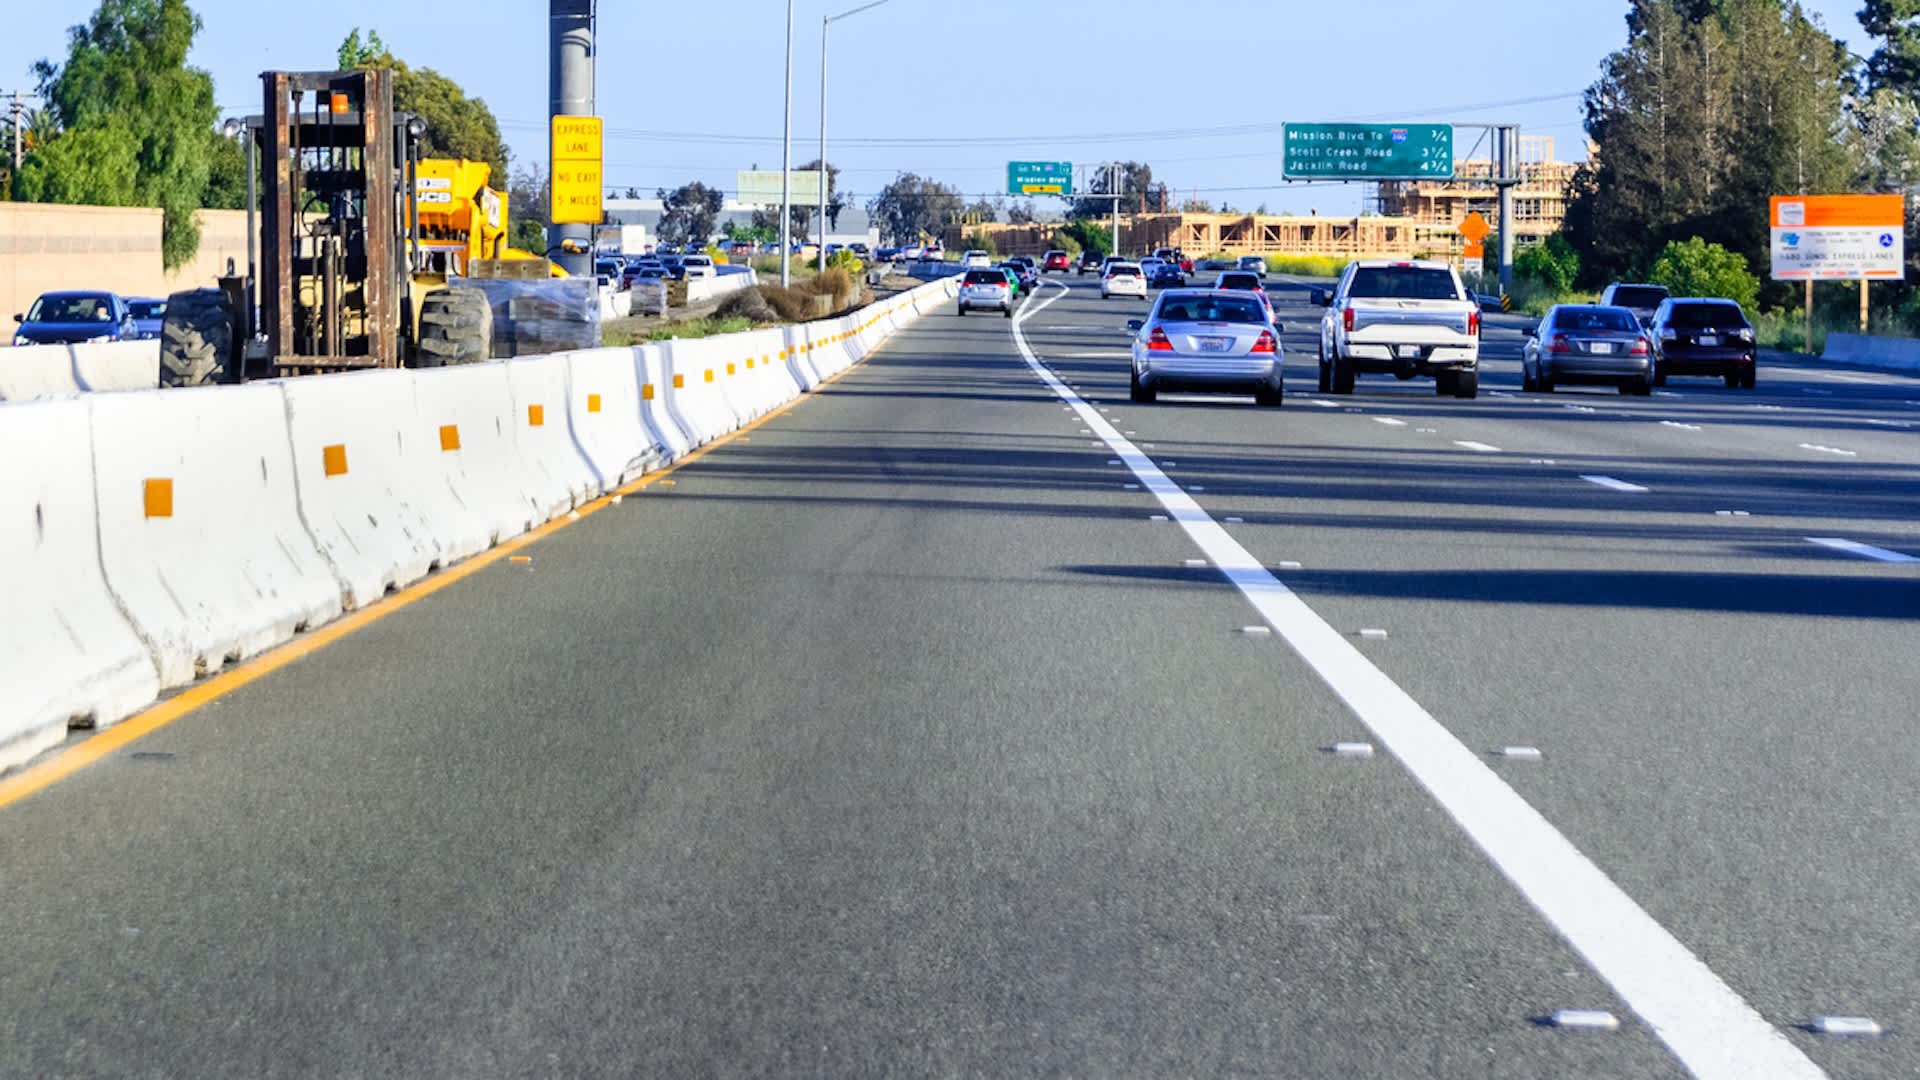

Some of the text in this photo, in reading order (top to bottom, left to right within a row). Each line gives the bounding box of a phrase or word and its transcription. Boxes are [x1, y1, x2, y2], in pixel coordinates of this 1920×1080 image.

[557, 124, 599, 135] EXPRESS
[1288, 130, 1334, 141] Mission
[1338, 130, 1364, 141] Blvd
[1371, 131, 1384, 141] To
[565, 142, 590, 153] LANE
[1289, 147, 1321, 158] Scott
[1326, 147, 1359, 158] Creek
[1364, 147, 1393, 158] Road
[1289, 161, 1334, 171] Jacklin
[1338, 161, 1368, 171] Road
[558, 172, 598, 183] NO EXIT
[570, 195, 598, 206] MILES
